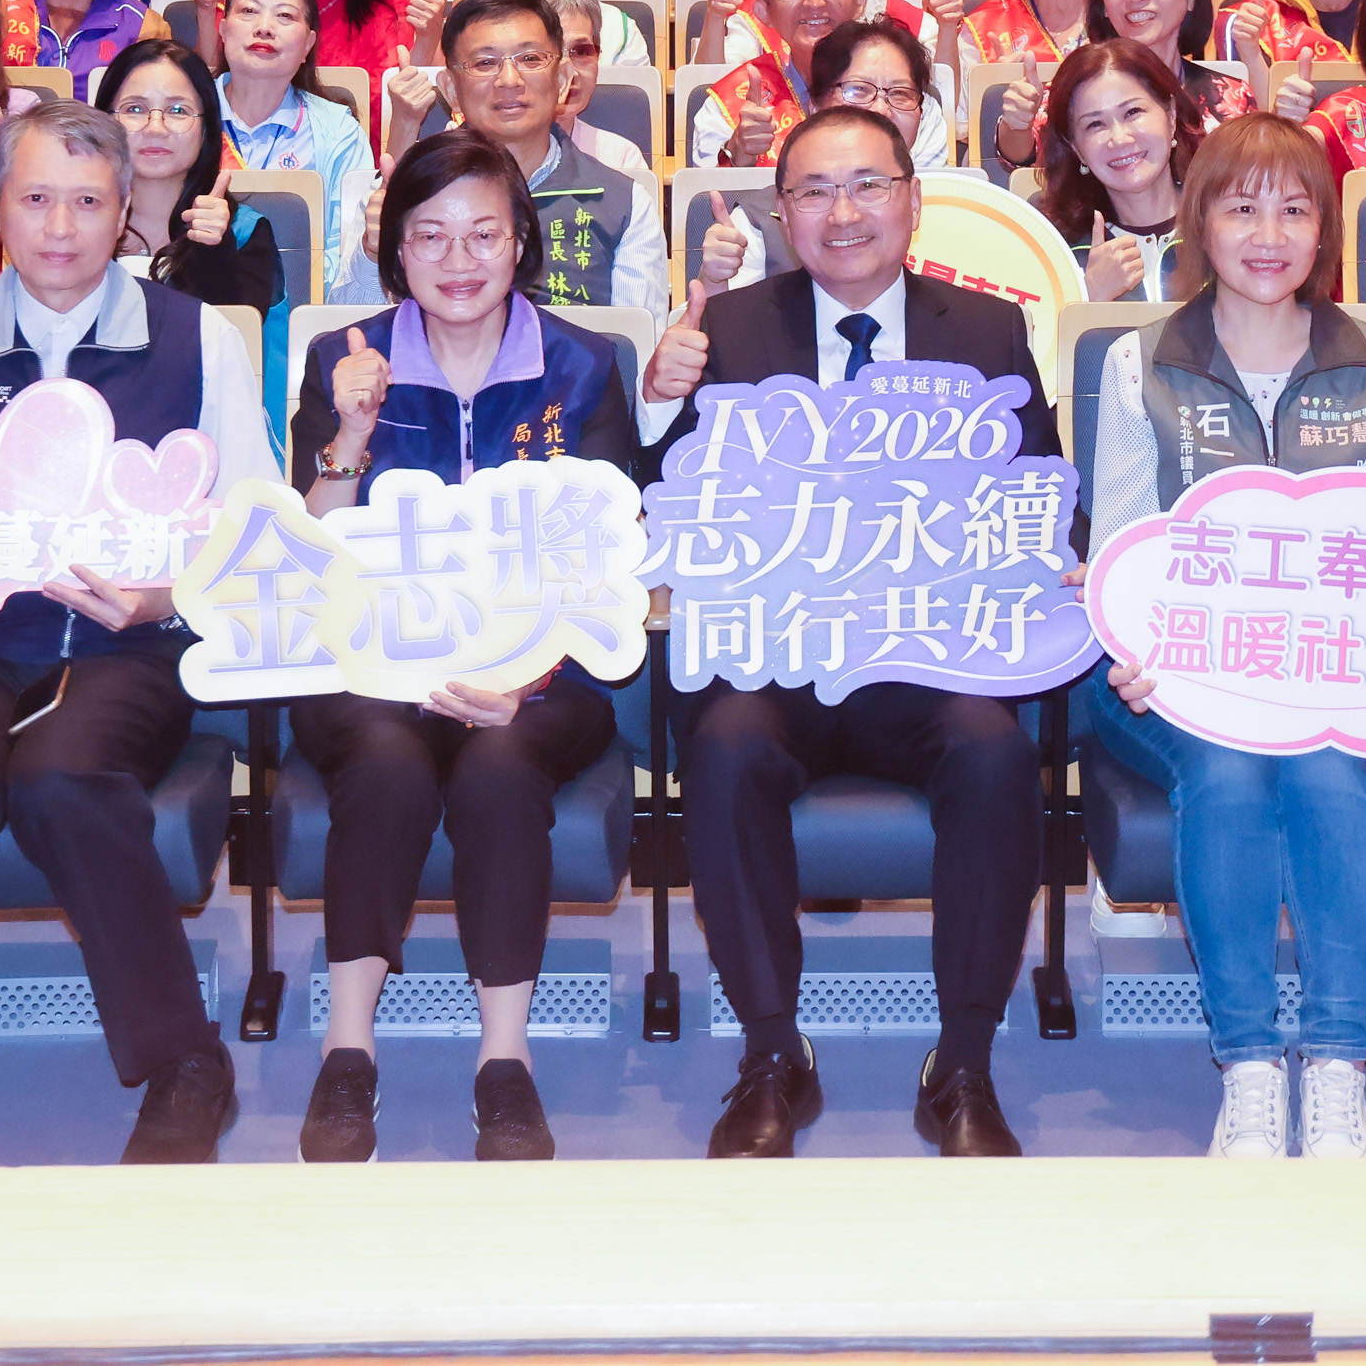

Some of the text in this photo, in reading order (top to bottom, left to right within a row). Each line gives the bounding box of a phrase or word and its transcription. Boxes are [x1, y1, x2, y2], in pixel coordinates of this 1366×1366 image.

[549, 219, 568, 262] 區長
[574, 208, 593, 271] 新北市
[869, 375, 974, 399] 愛蔓延新北
[1321, 410, 1341, 422] 創新
[1179, 416, 1195, 486] 新北市議員
[646, 472, 1065, 589] 志力永續
[200, 486, 622, 675] 金志獎
[686, 583, 1047, 677] 同行共好
